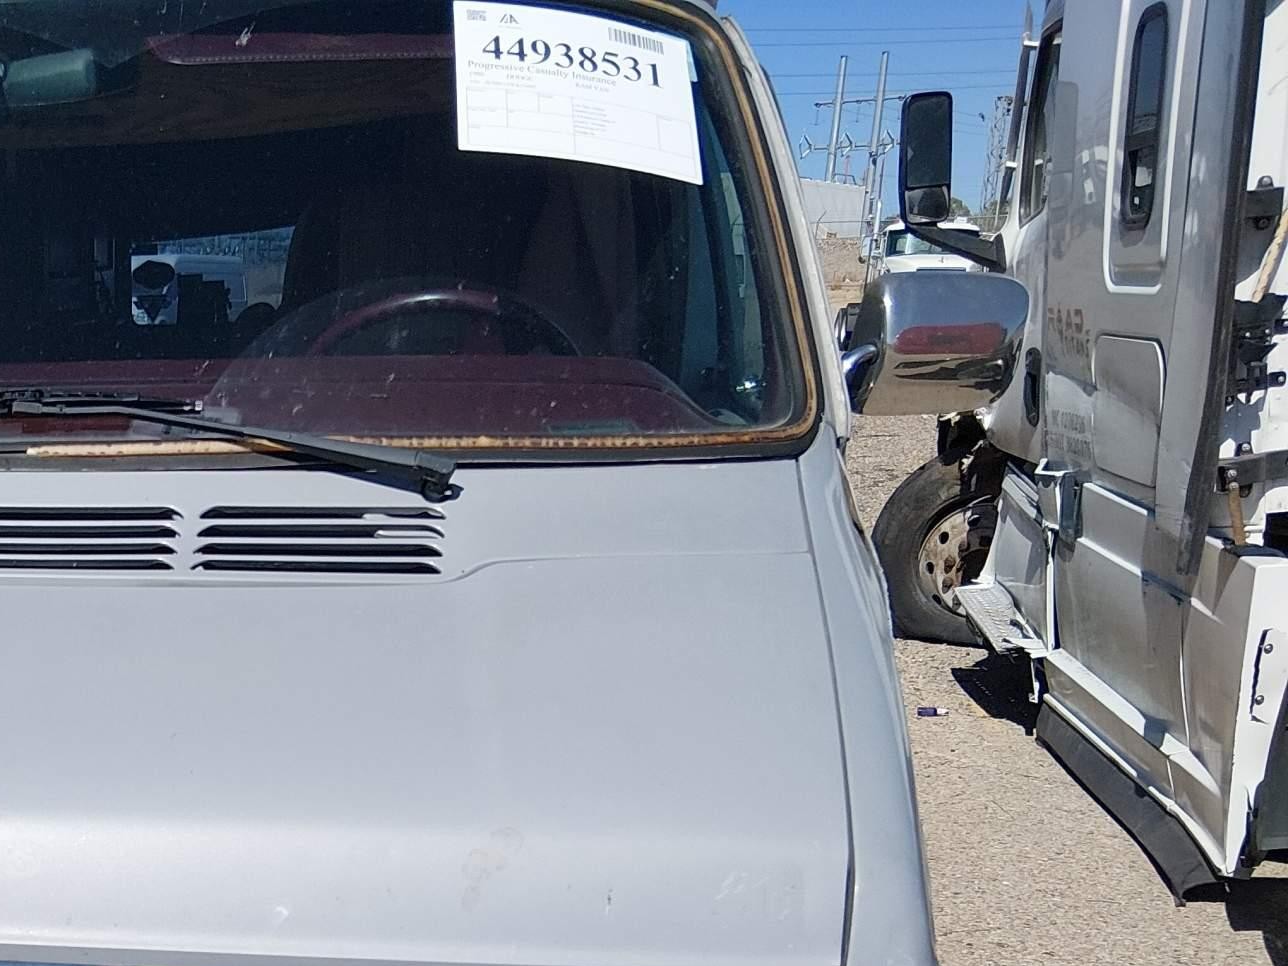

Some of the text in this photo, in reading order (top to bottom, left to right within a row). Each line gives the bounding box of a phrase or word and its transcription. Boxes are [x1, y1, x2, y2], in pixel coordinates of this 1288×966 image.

[468, 60, 617, 87] Progressive Casualty Insurance
[482, 35, 664, 88] 44938531
